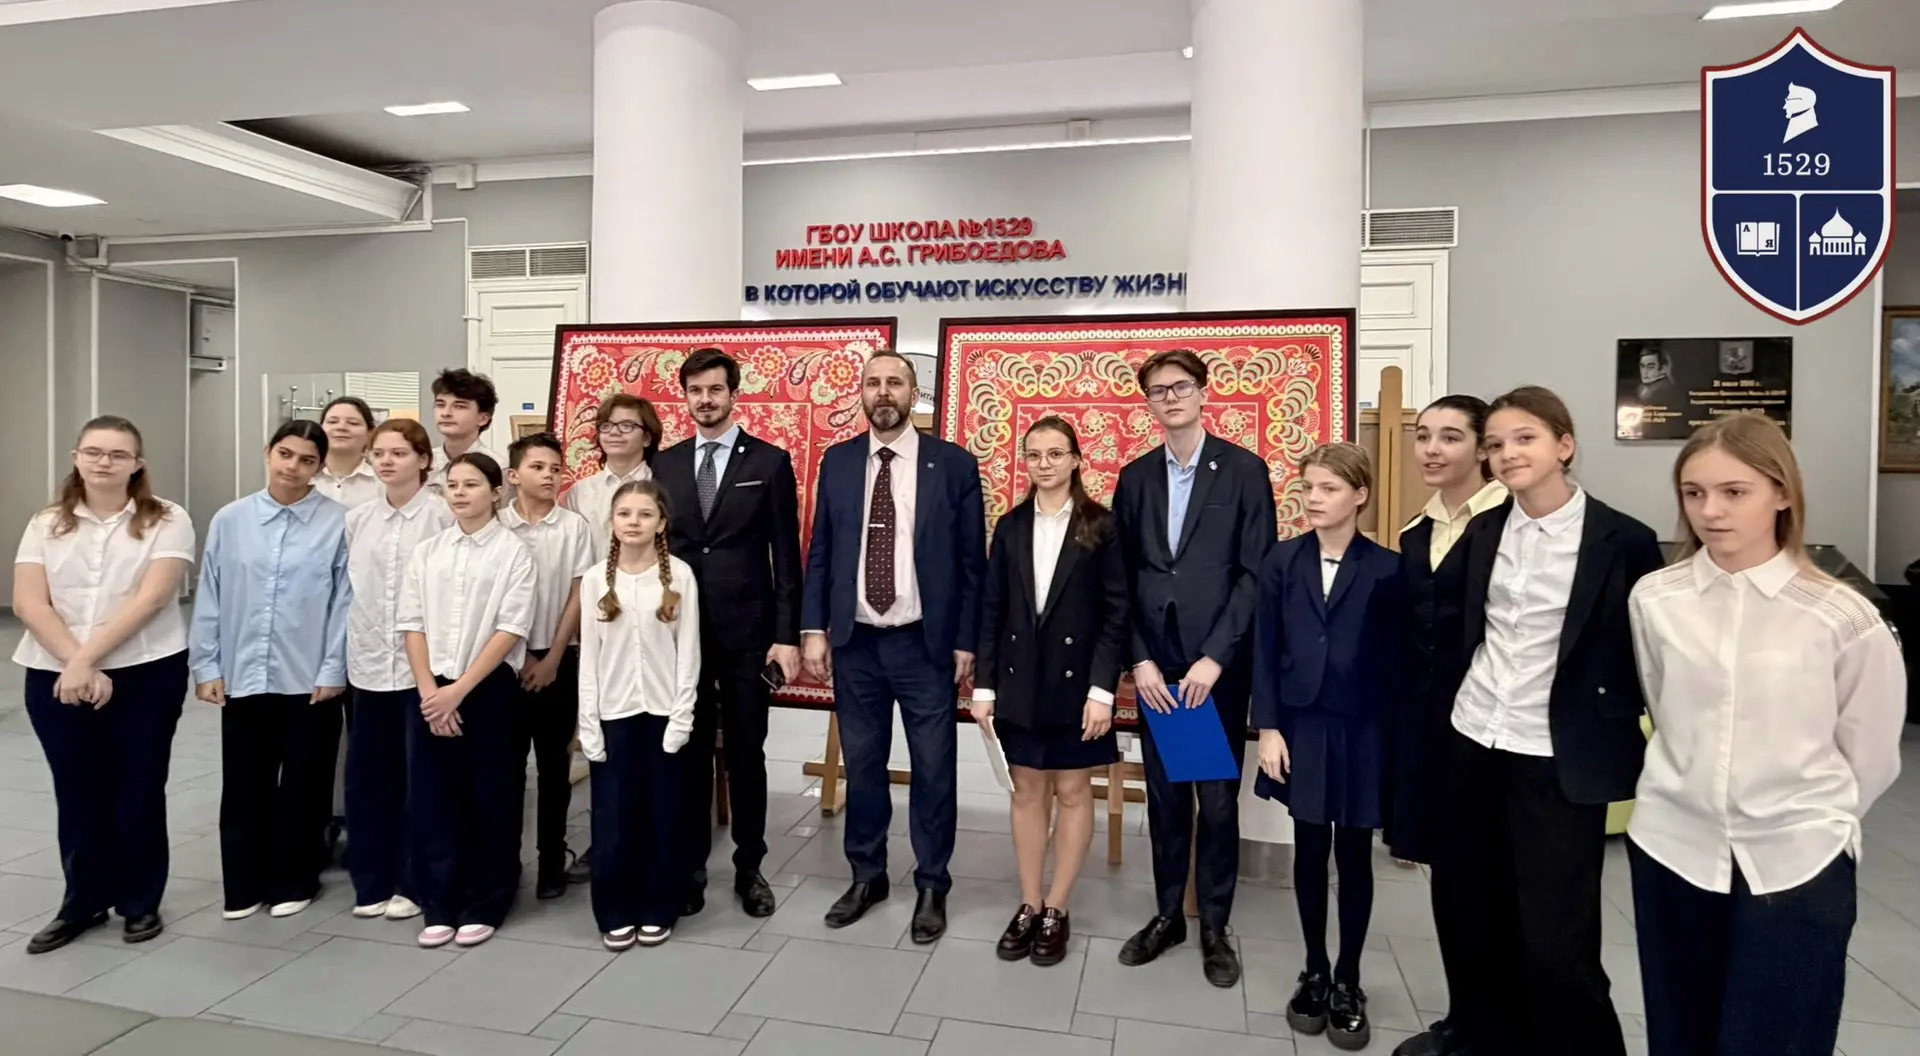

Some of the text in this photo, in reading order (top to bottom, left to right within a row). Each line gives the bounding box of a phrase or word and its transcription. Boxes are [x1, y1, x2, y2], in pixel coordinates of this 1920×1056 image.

[806, 216, 1034, 245] ГБОУ ШКОЛА №1529
[775, 239, 1067, 270] ИМЕНИ А.С. ГРИБОЕДОВА
[745, 271, 1187, 303] В КОТОРОЙ ОБУЧАЮТ ИСКУССТВУ ЖИЗН
